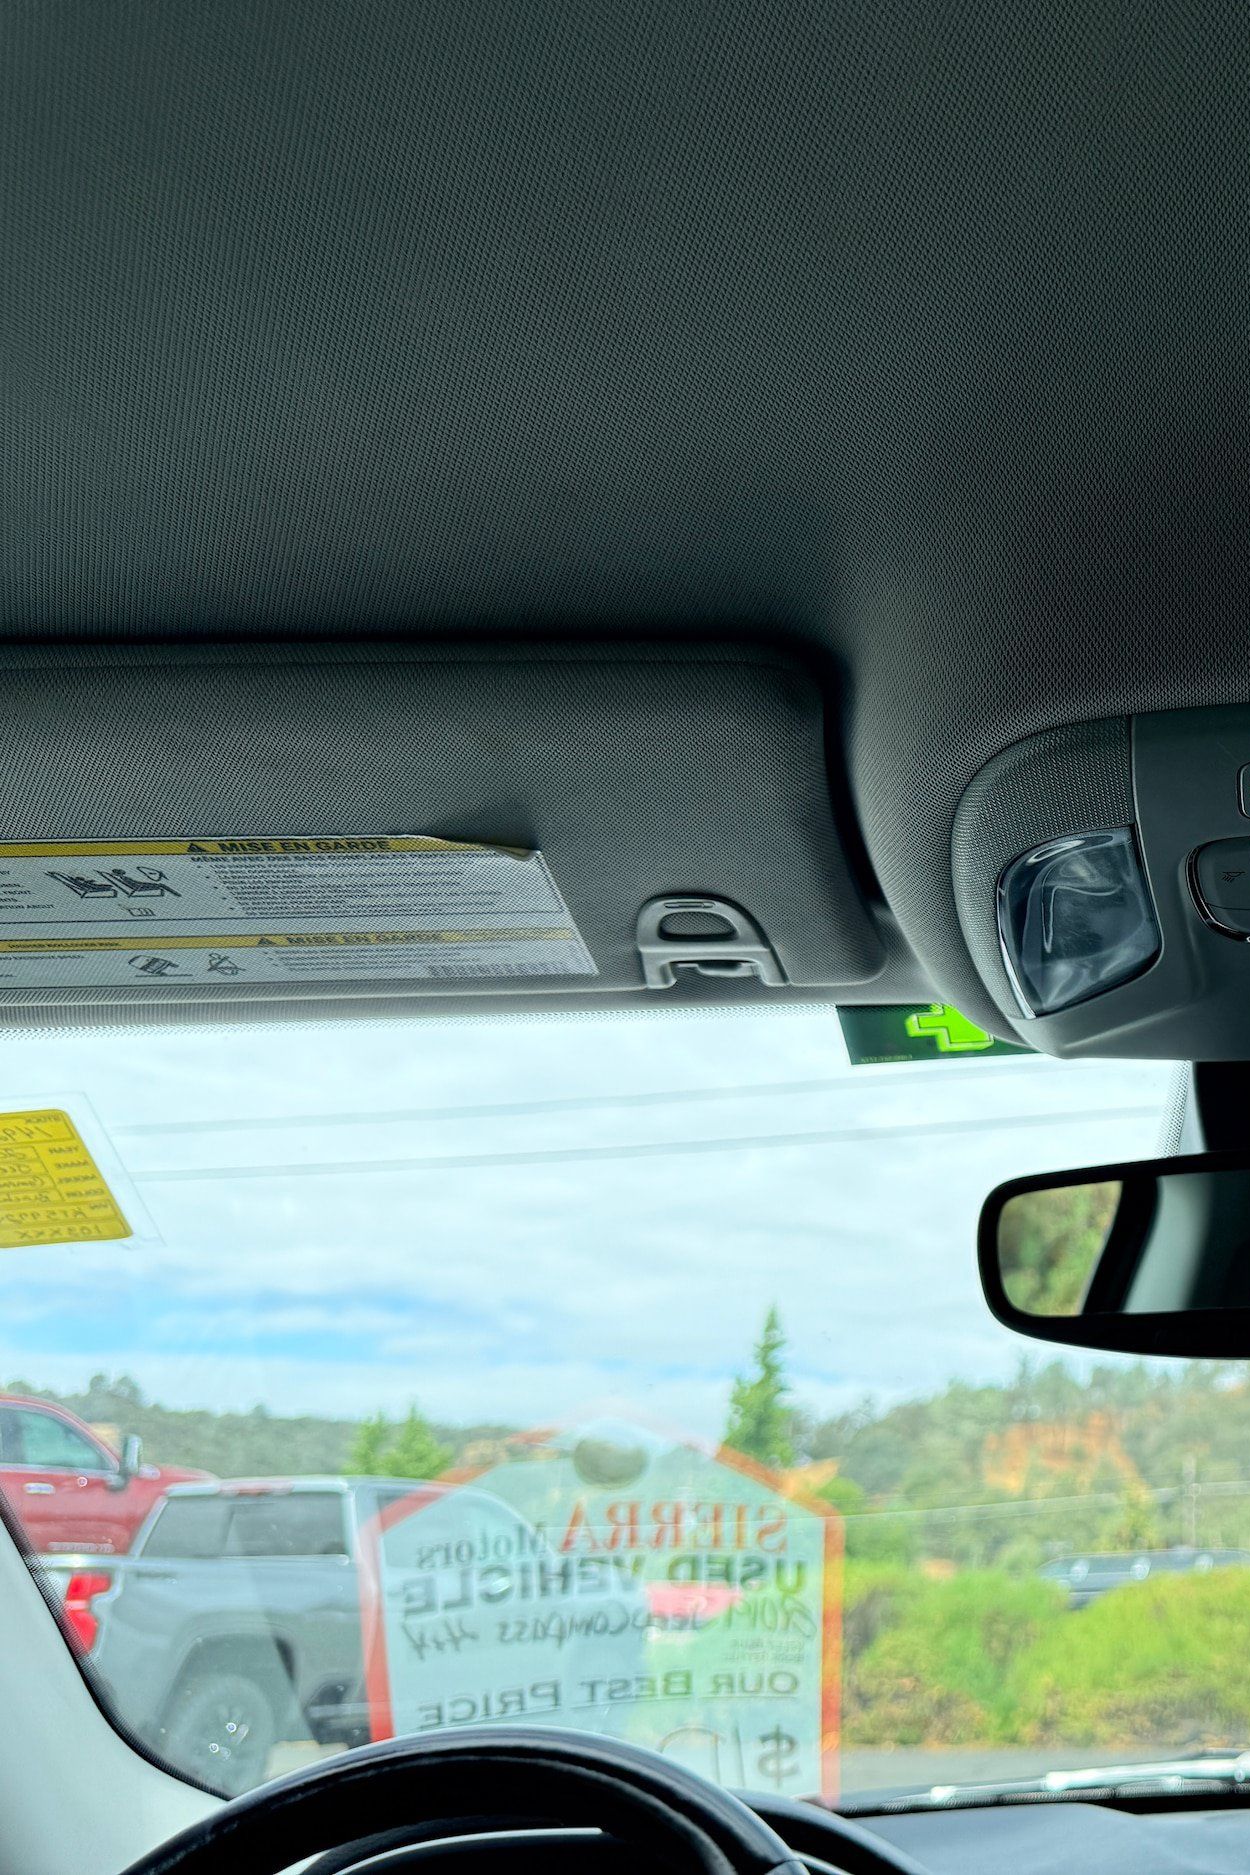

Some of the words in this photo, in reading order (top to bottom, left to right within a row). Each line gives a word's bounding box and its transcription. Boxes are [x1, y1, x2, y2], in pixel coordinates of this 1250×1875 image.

[218, 841, 276, 853] MISE
[280, 841, 311, 852] EN
[316, 840, 391, 852] GARDE
